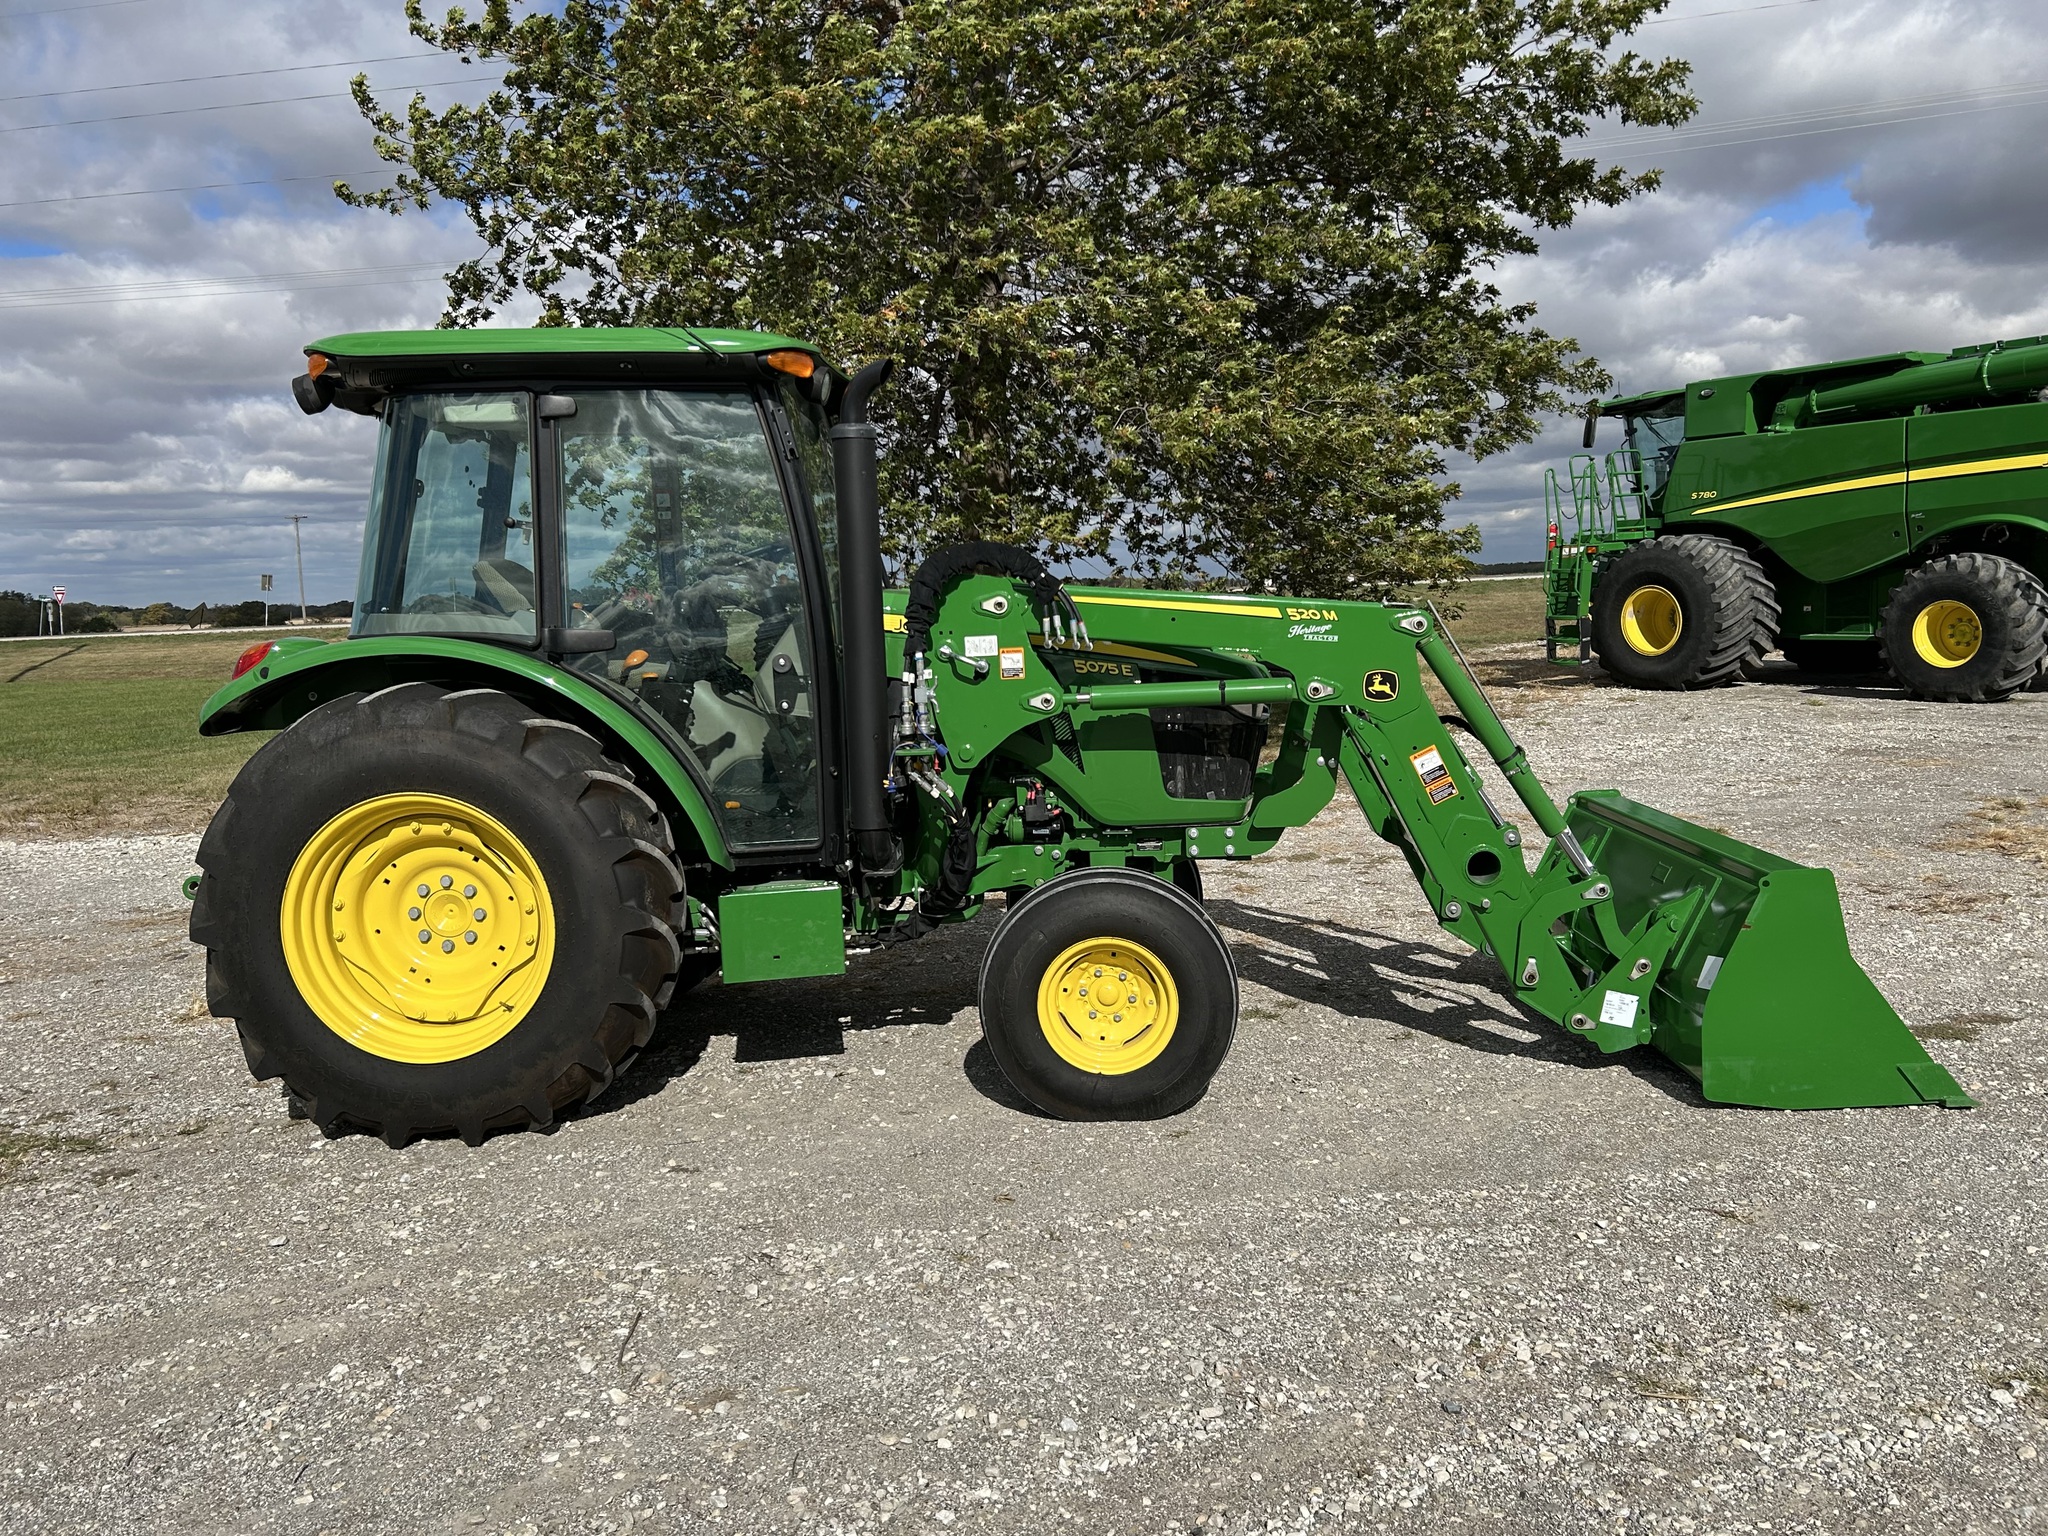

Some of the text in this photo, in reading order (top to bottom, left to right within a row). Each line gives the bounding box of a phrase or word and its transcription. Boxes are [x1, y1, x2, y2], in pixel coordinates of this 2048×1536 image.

[1286, 607, 1339, 621] 520 M
[1287, 623, 1333, 638] Heritage
[1303, 634, 1339, 642] TRACTOR
[1073, 659, 1134, 676] 5075 E
